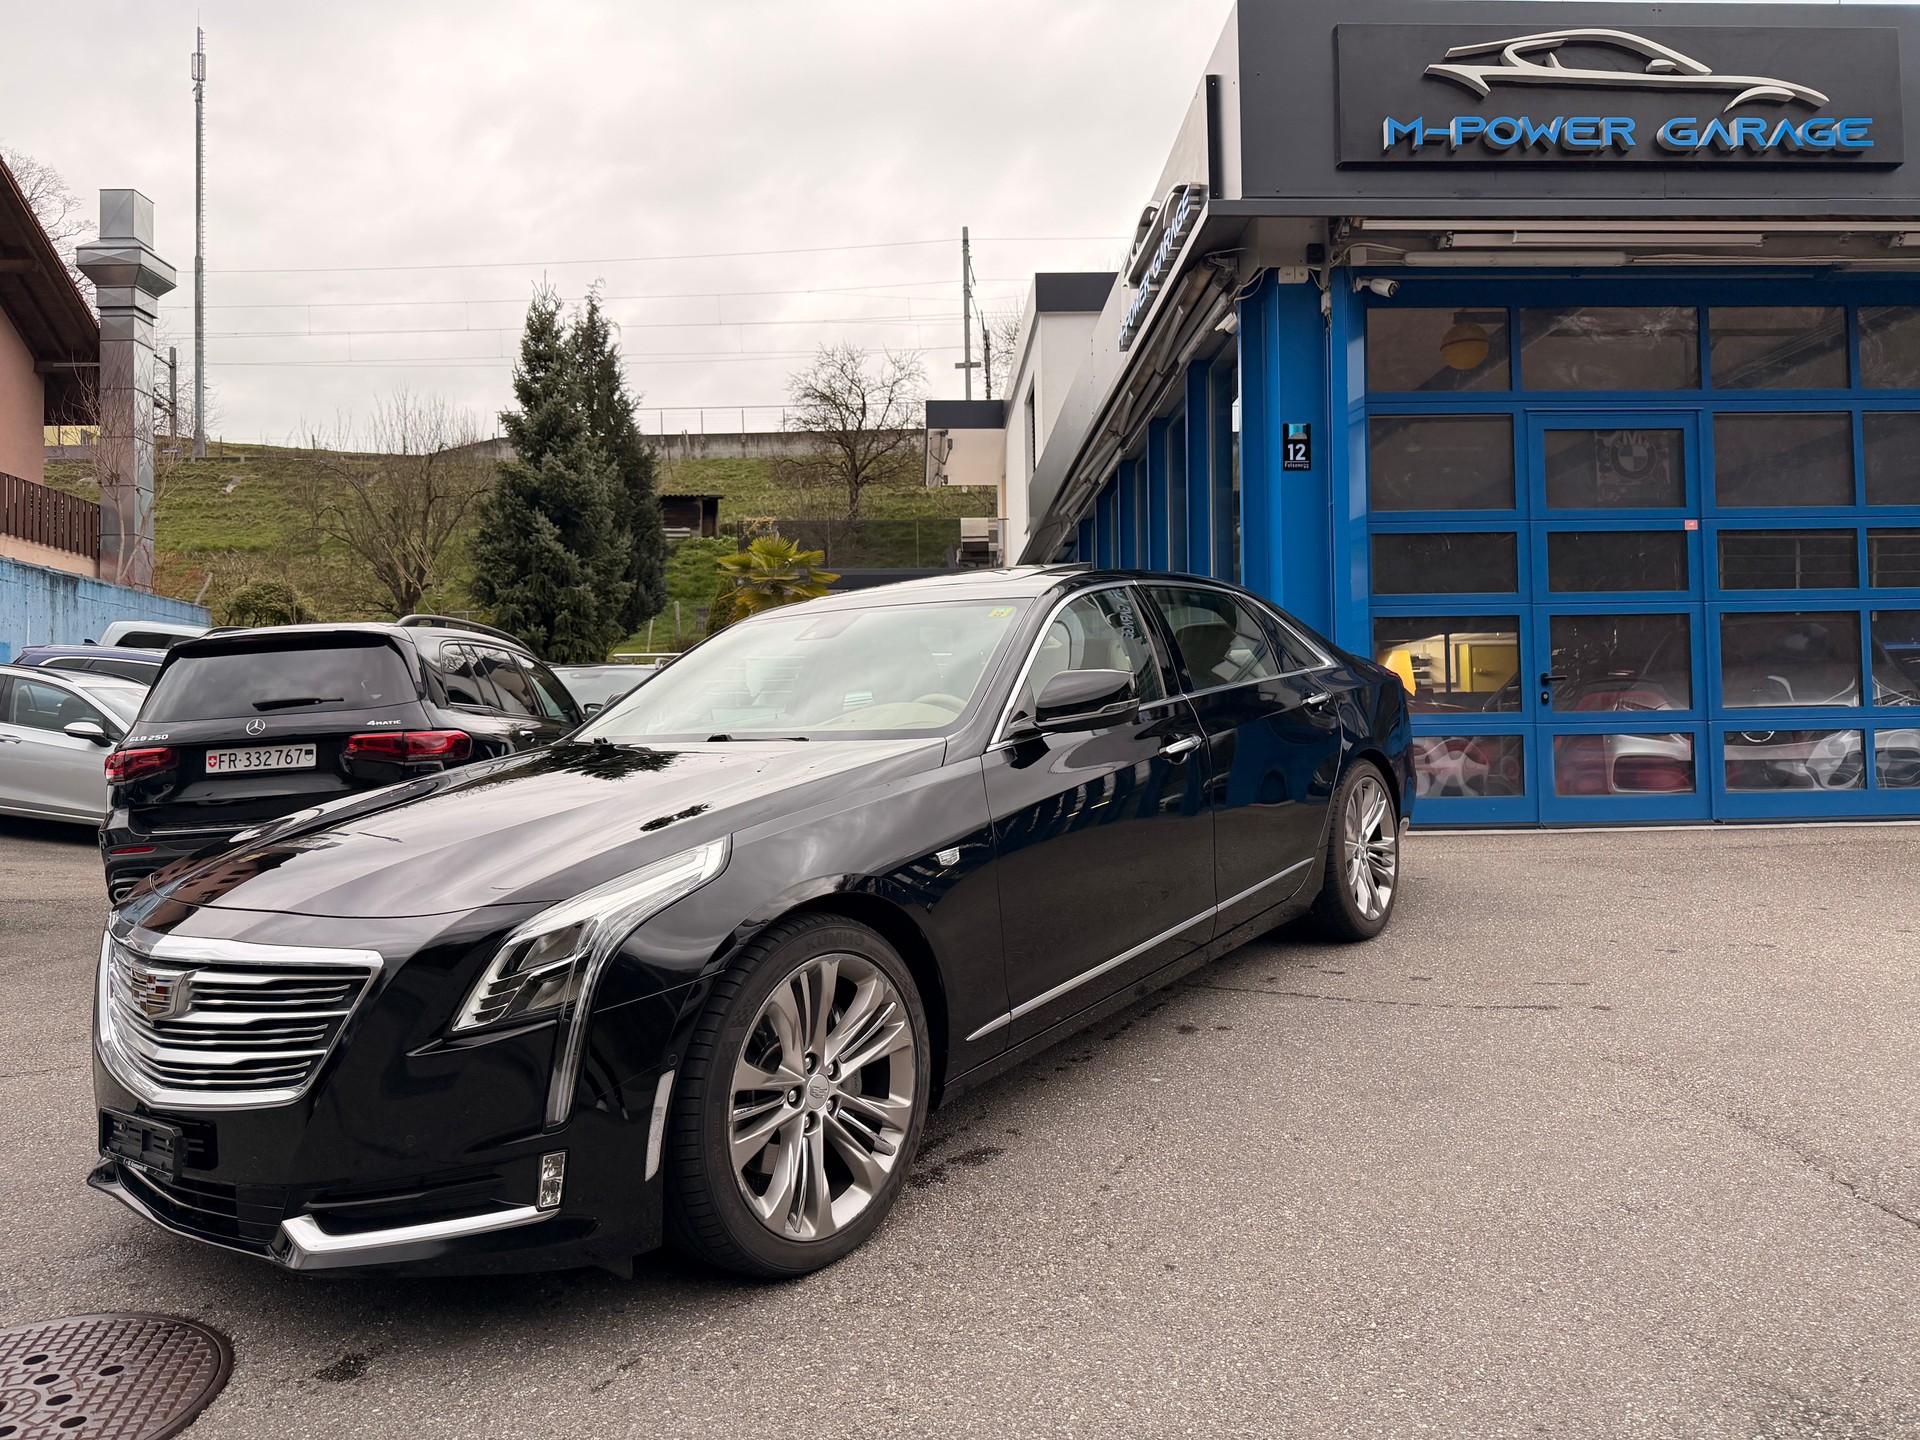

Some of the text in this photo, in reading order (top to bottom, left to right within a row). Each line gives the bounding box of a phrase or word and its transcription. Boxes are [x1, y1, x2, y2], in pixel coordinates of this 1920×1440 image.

[1384, 116, 1874, 148] M-POWER GARAGE
[1151, 184, 1190, 279] GARAGE
[1287, 443, 1306, 461] 12
